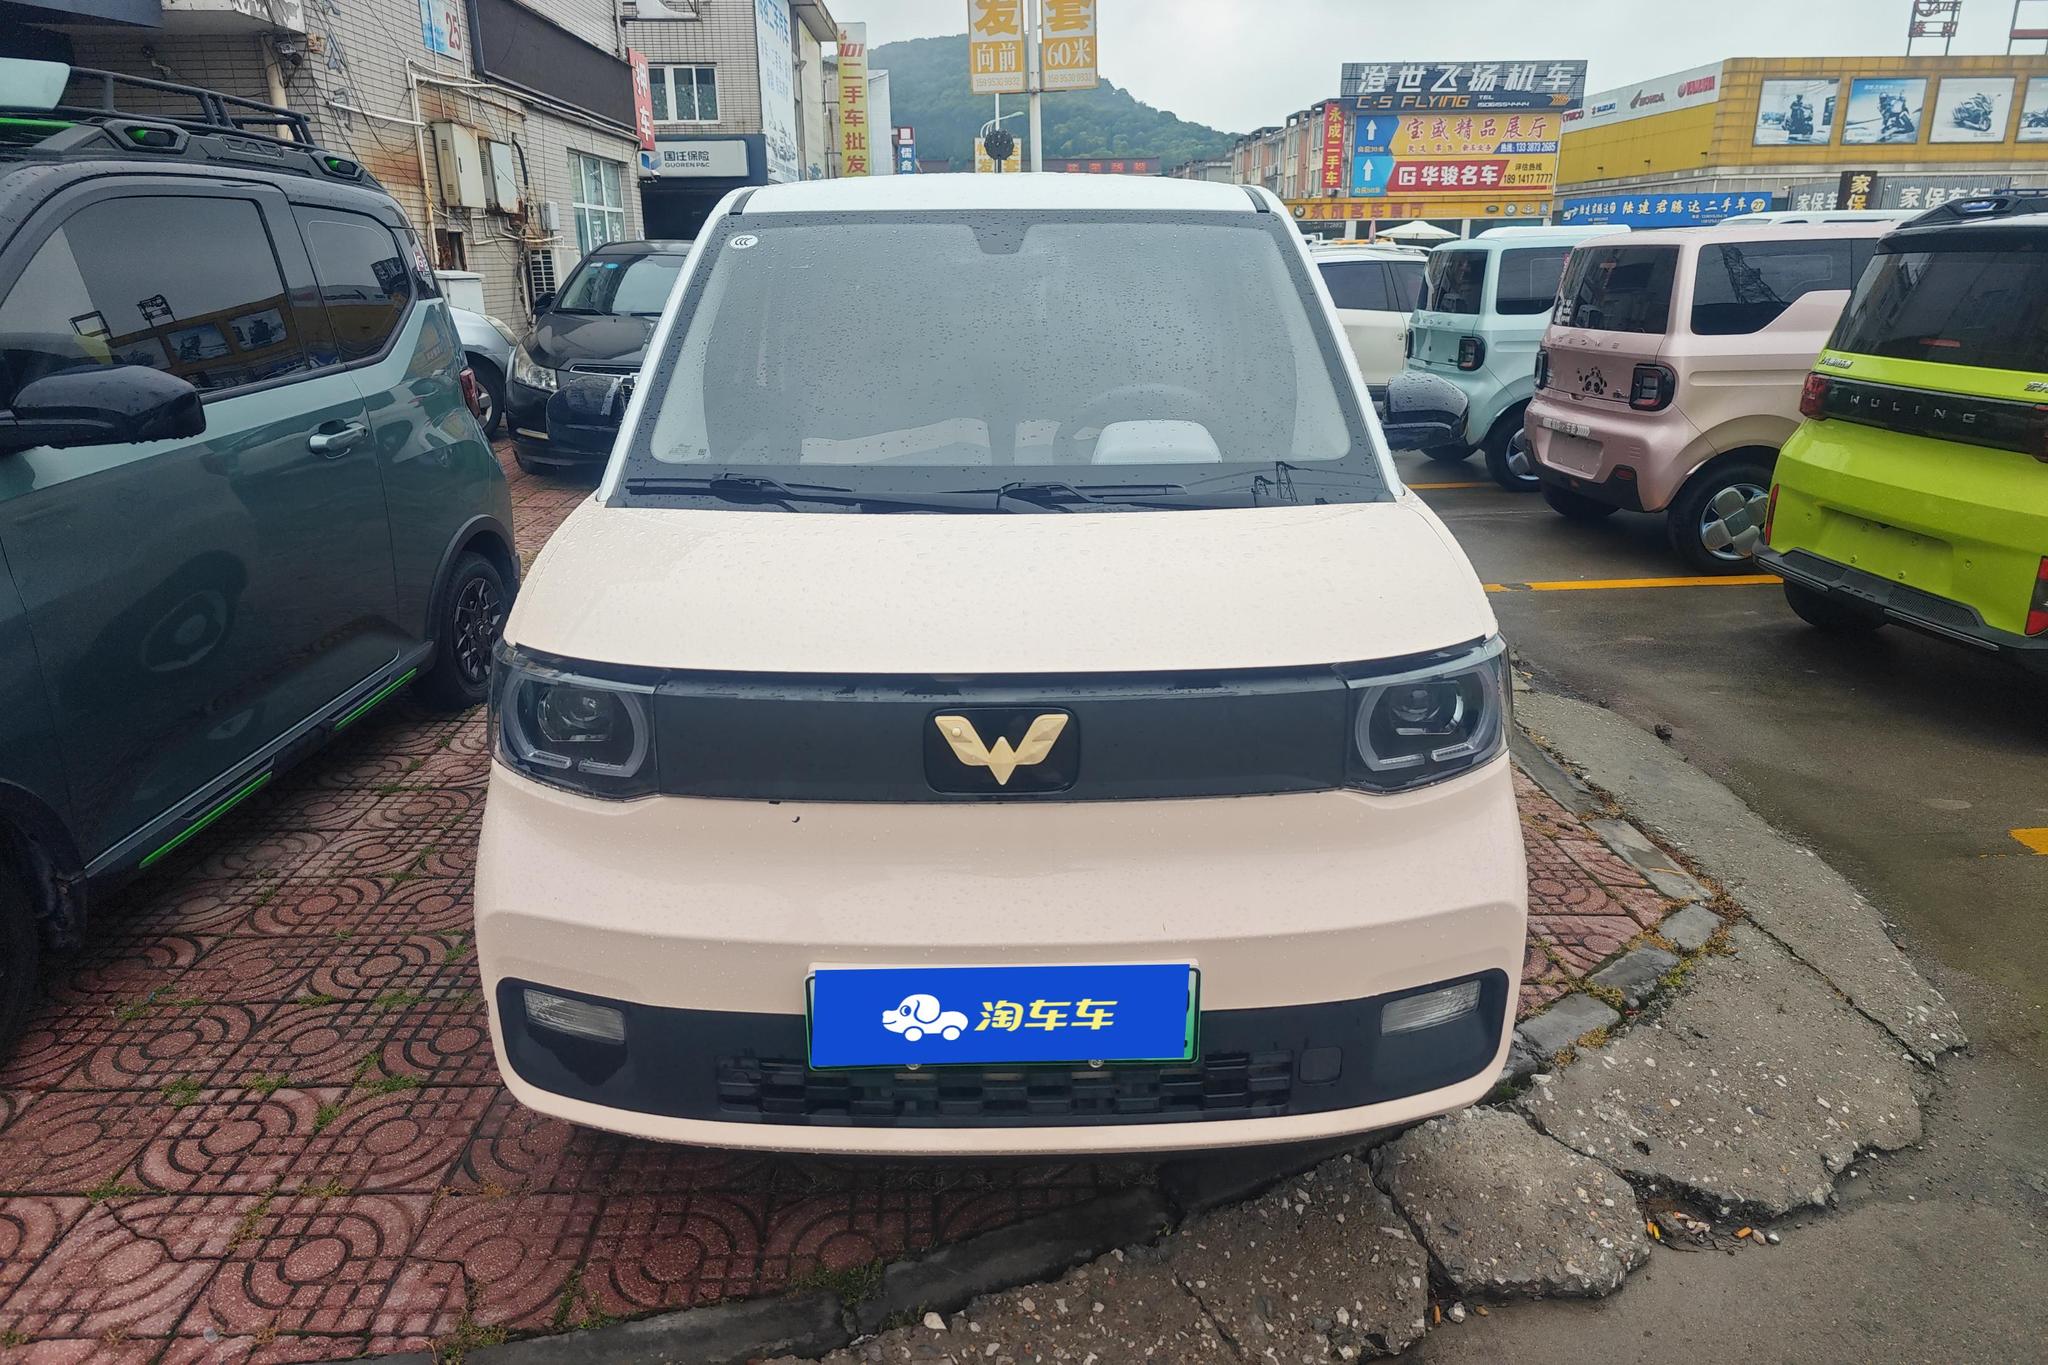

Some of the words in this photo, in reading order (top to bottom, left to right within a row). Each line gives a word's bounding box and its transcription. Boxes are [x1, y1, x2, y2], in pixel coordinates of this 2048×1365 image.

[977, 43, 1016, 72] 向前
[1047, 39, 1091, 67] 60米
[1357, 63, 1577, 93] 澄世飞扬机车
[1686, 75, 1715, 96] YAMAHA
[634, 61, 651, 141] 押车
[1400, 95, 1471, 108] FLYING
[1639, 93, 1666, 107] HONDA
[842, 62, 867, 173] 二手车批发
[664, 151, 710, 161] 国任保险
[1326, 106, 1342, 186] 永成二手车
[1420, 165, 1499, 186] 华骏名车
[1504, 174, 1516, 184] 189
[1847, 175, 1872, 210] 家保
[1851, 394, 1976, 424] WULING
